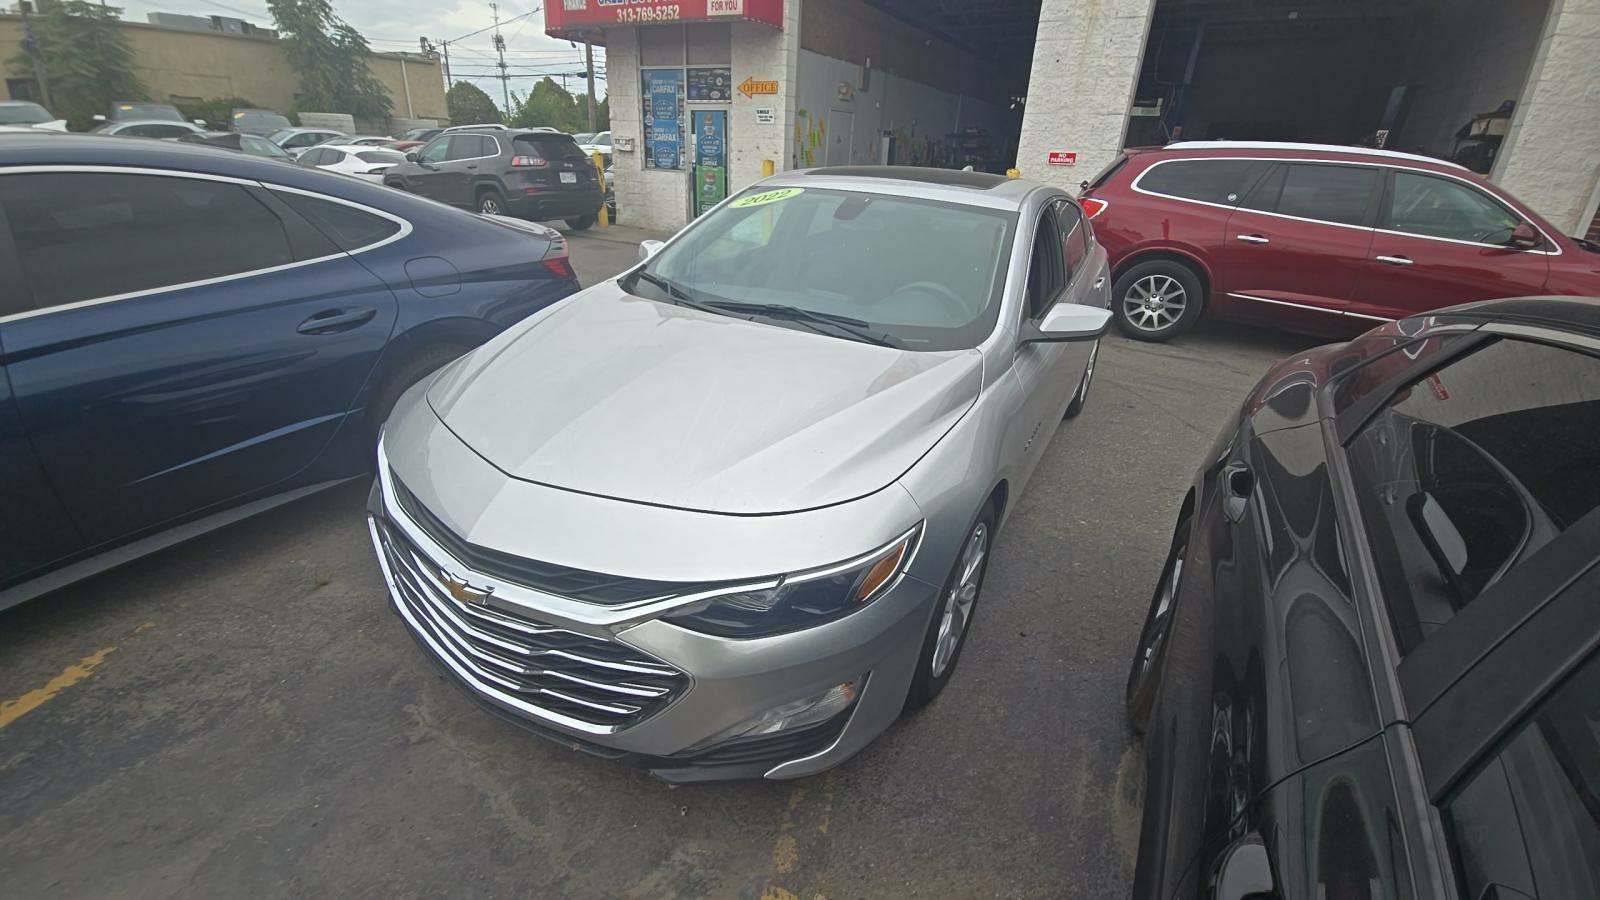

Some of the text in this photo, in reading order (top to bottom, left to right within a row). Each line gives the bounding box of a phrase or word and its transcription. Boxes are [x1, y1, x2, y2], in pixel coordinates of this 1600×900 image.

[711, 0, 738, 11] FOR YOU
[616, 5, 680, 22] 313-769-5252
[743, 82, 776, 92] OFFICE
[654, 133, 677, 141] CARFAX
[740, 189, 793, 206] 2022
